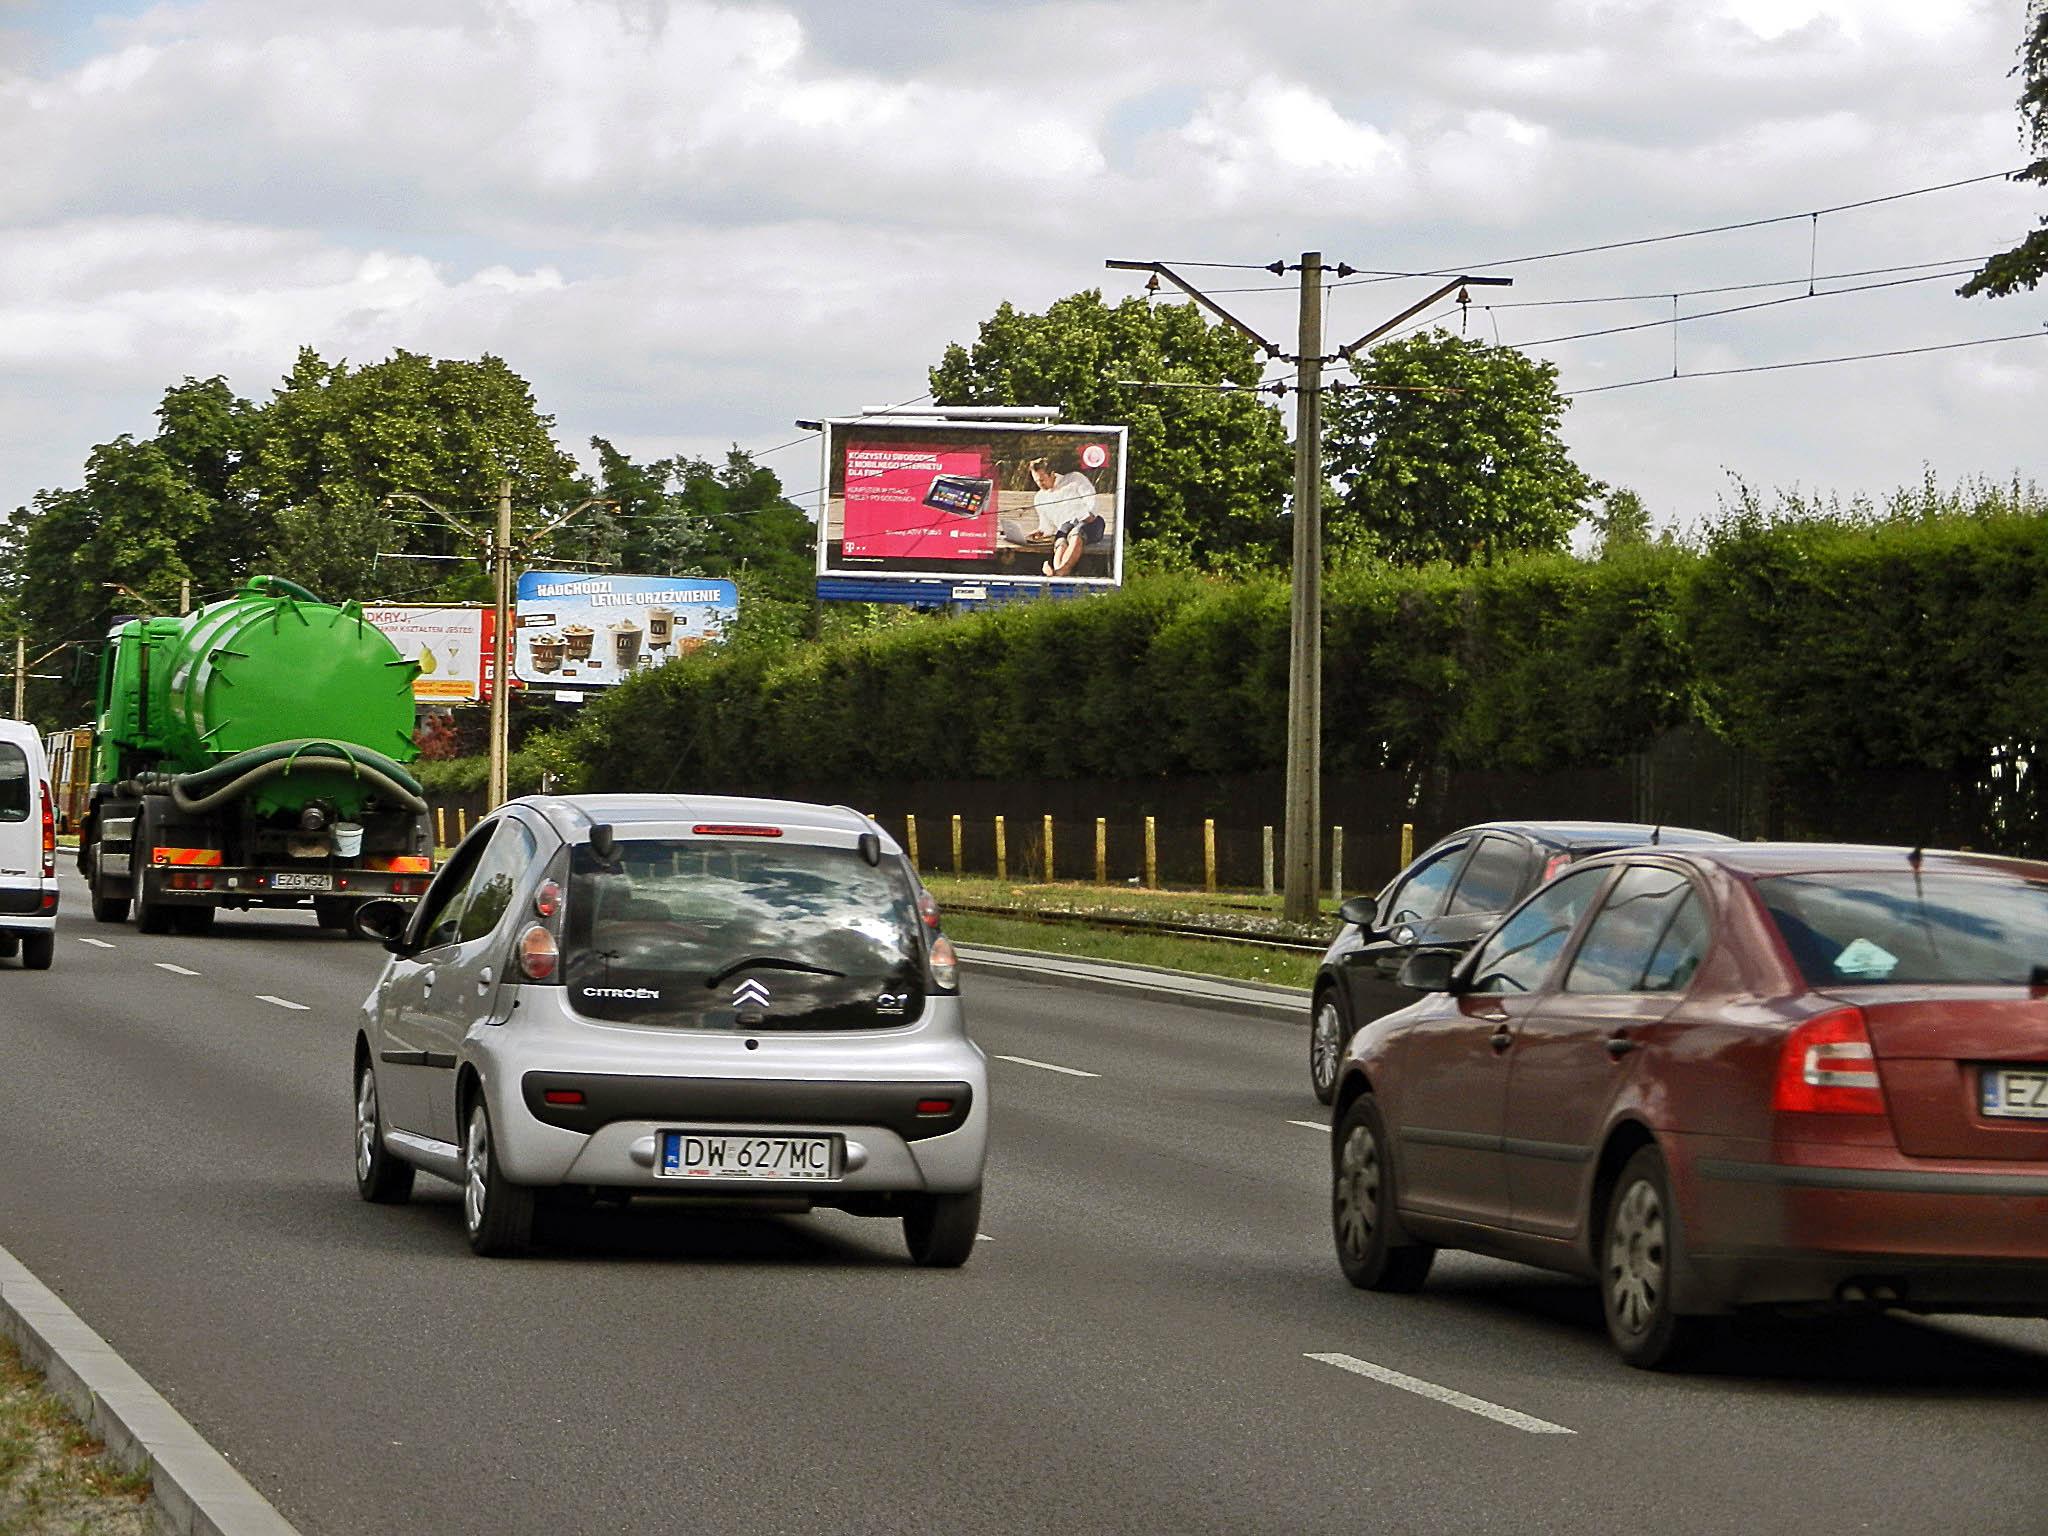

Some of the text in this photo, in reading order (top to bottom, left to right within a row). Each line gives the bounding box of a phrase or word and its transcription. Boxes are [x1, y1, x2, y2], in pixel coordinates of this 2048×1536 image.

[848, 452, 891, 460] KORZYSTAJ
[537, 582, 612, 597] NADCHODZI
[591, 592, 633, 607] LETNIE
[278, 874, 301, 886] EZG
[583, 987, 660, 999] CITROËN
[685, 1138, 825, 1169] DW 627MC
